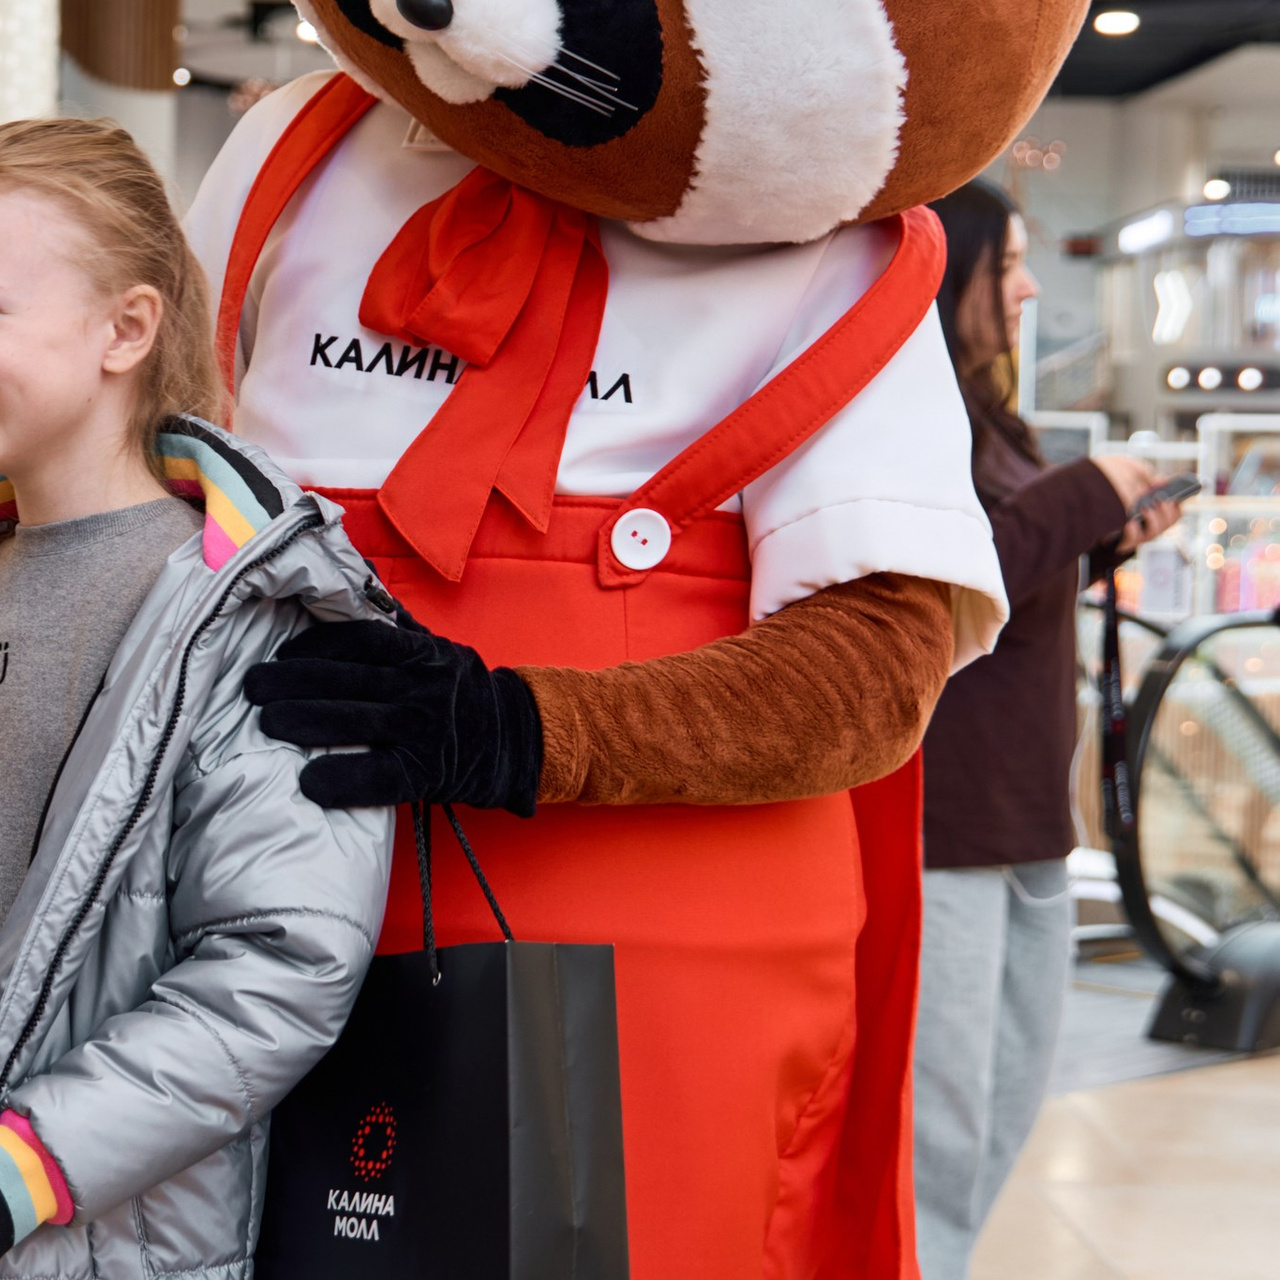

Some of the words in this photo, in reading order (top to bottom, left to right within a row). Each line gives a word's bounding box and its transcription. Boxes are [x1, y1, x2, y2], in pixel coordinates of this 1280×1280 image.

[310, 333, 466, 384] КАЛИН
[327, 1189, 395, 1217] КАЛИНА
[334, 1215, 379, 1241] МОЛЛ
